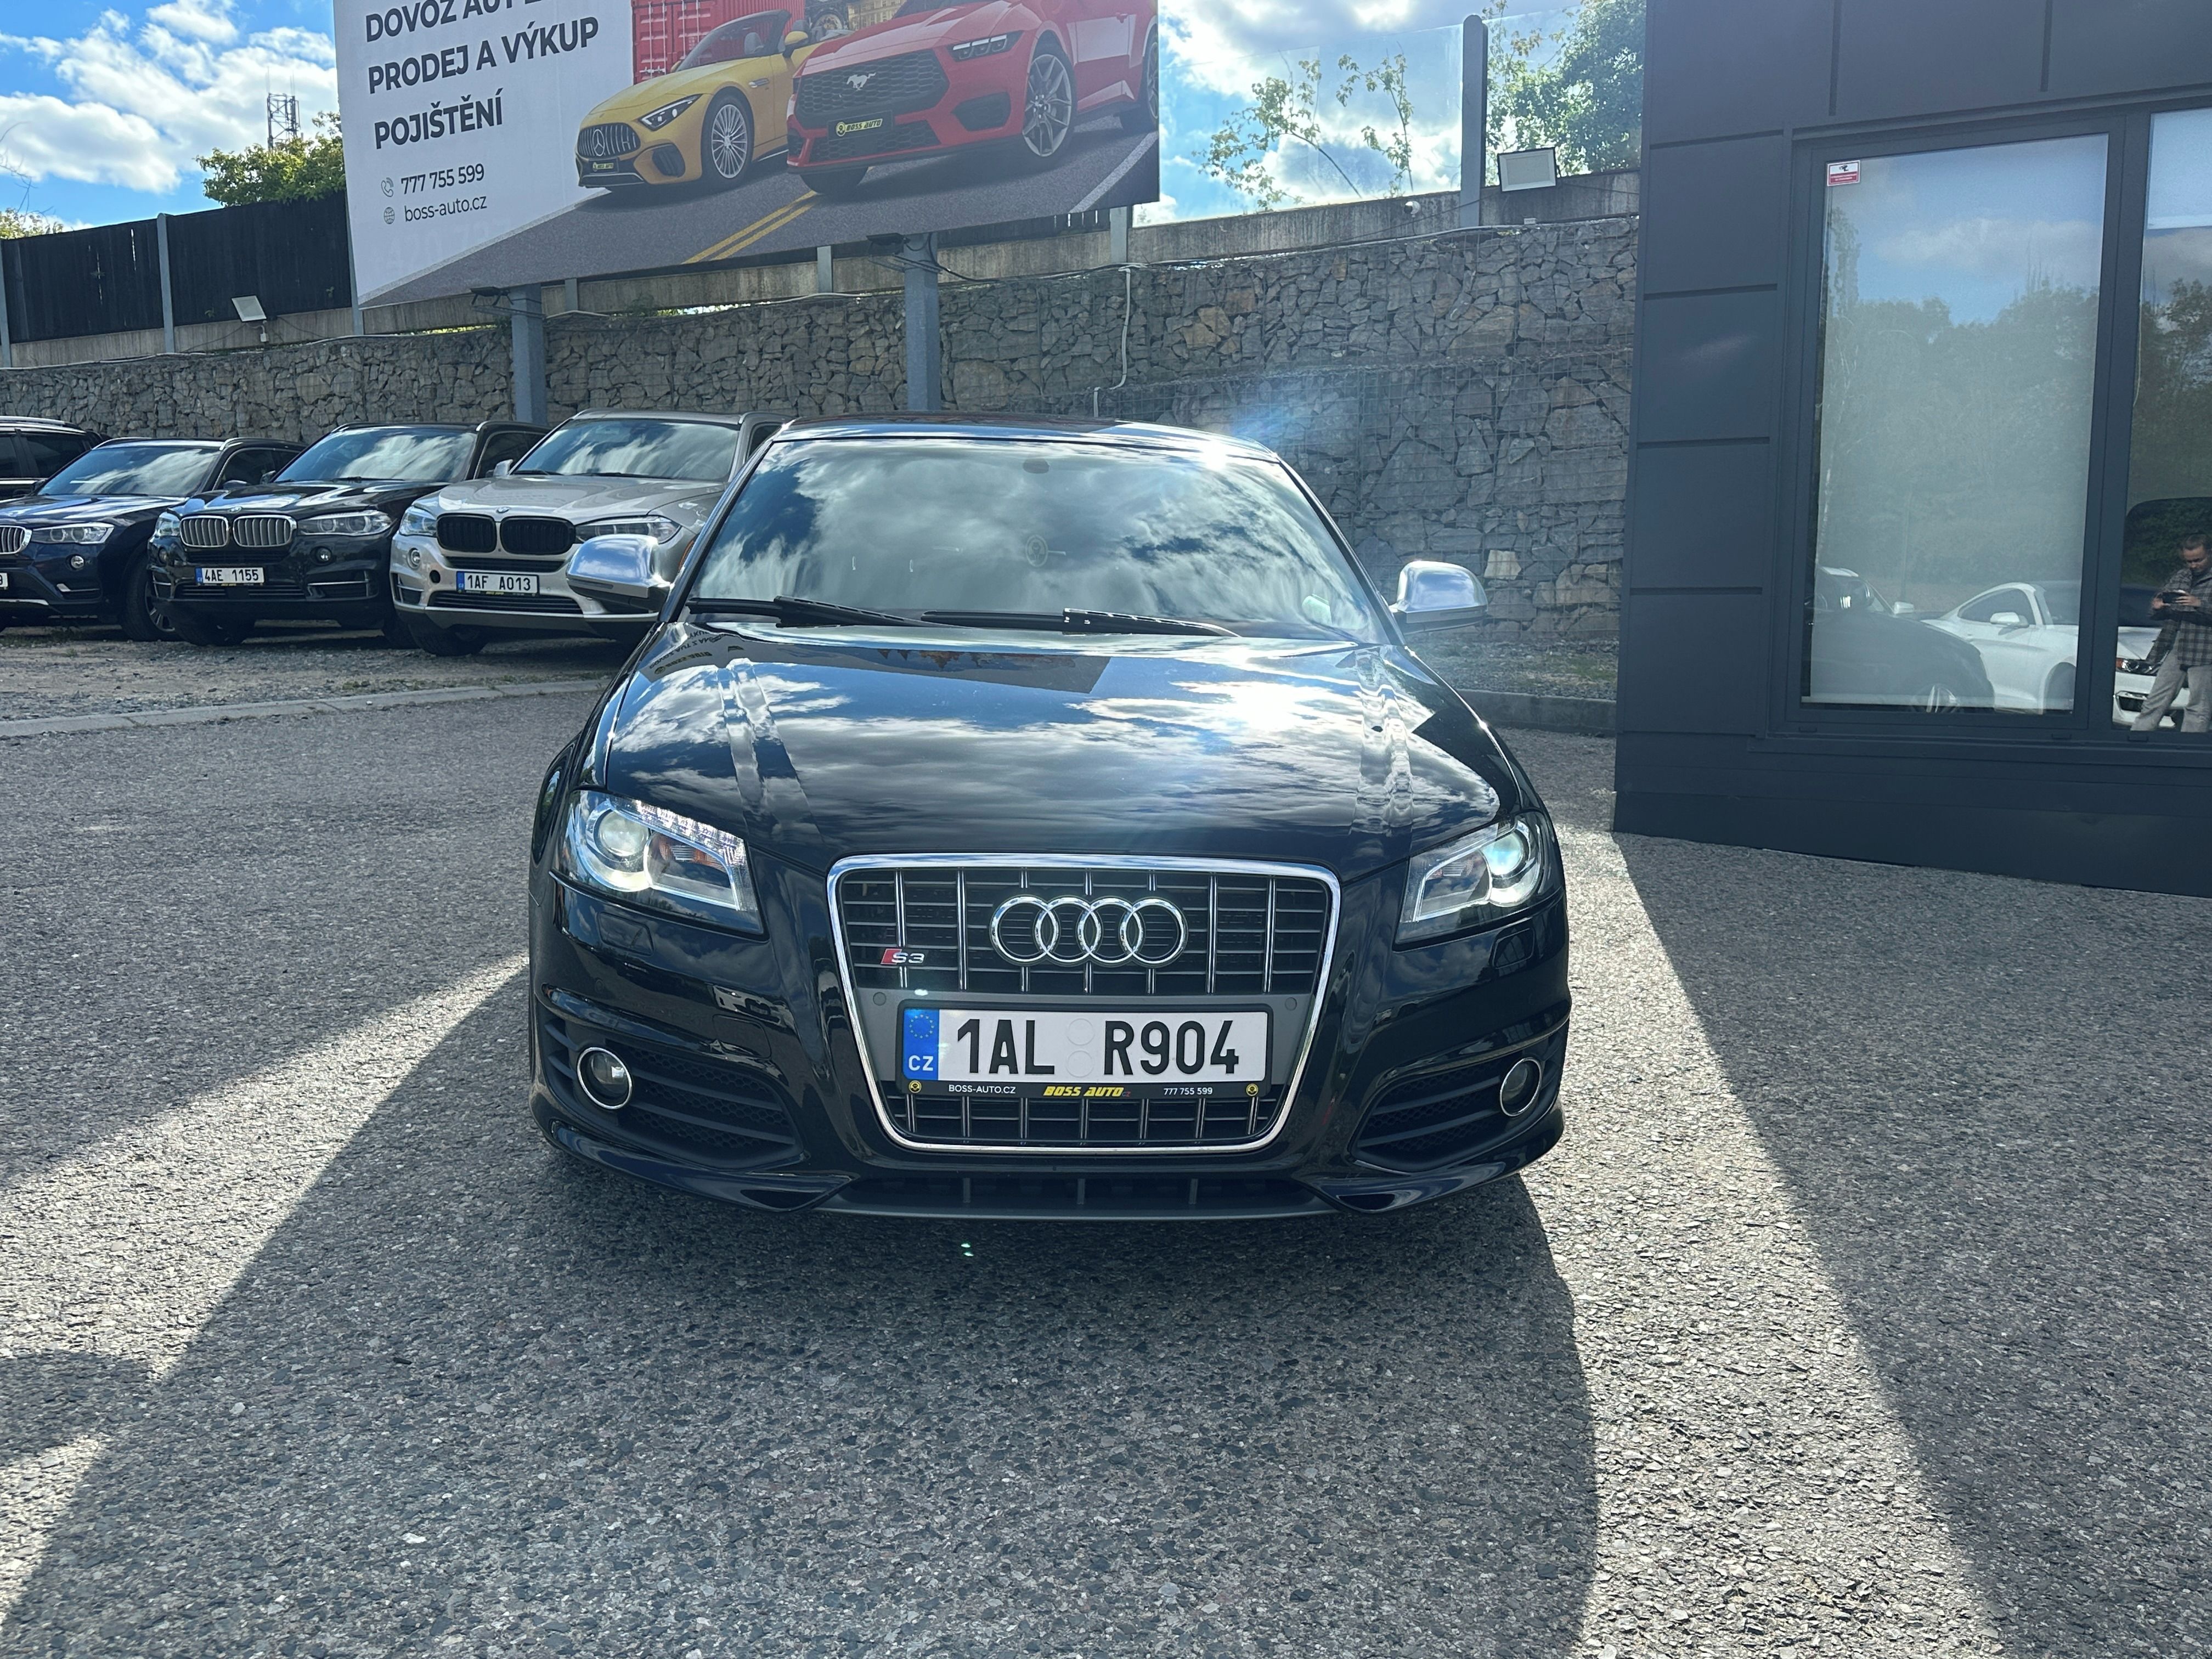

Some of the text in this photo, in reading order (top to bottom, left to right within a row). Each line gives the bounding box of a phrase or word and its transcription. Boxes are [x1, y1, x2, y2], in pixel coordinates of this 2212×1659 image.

[365, 0, 457, 42] DOVOZ
[369, 17, 599, 94] PRODEJ A VÝKUP
[374, 88, 504, 149] POJIŠTĚNÍ
[846, 120, 882, 131] BOSS AUTO
[401, 163, 485, 195] 777 755 599
[404, 195, 487, 222] boss-auto.cz
[205, 569, 223, 582] 4AE
[232, 569, 259, 582] 1155
[467, 574, 489, 589] 1AF
[499, 576, 531, 591] A013
[891, 952, 925, 964] S3
[908, 1019, 1239, 1075] CZ 1AL R904
[948, 1084, 1016, 1094] BOSS-AUTO.CZ
[1043, 1086, 1081, 1097] BOSS
[1084, 1086, 1124, 1097] AUTO
[1164, 1087, 1177, 1096] 777
[1180, 1087, 1194, 1096] 755
[1197, 1087, 1213, 1095] 599
